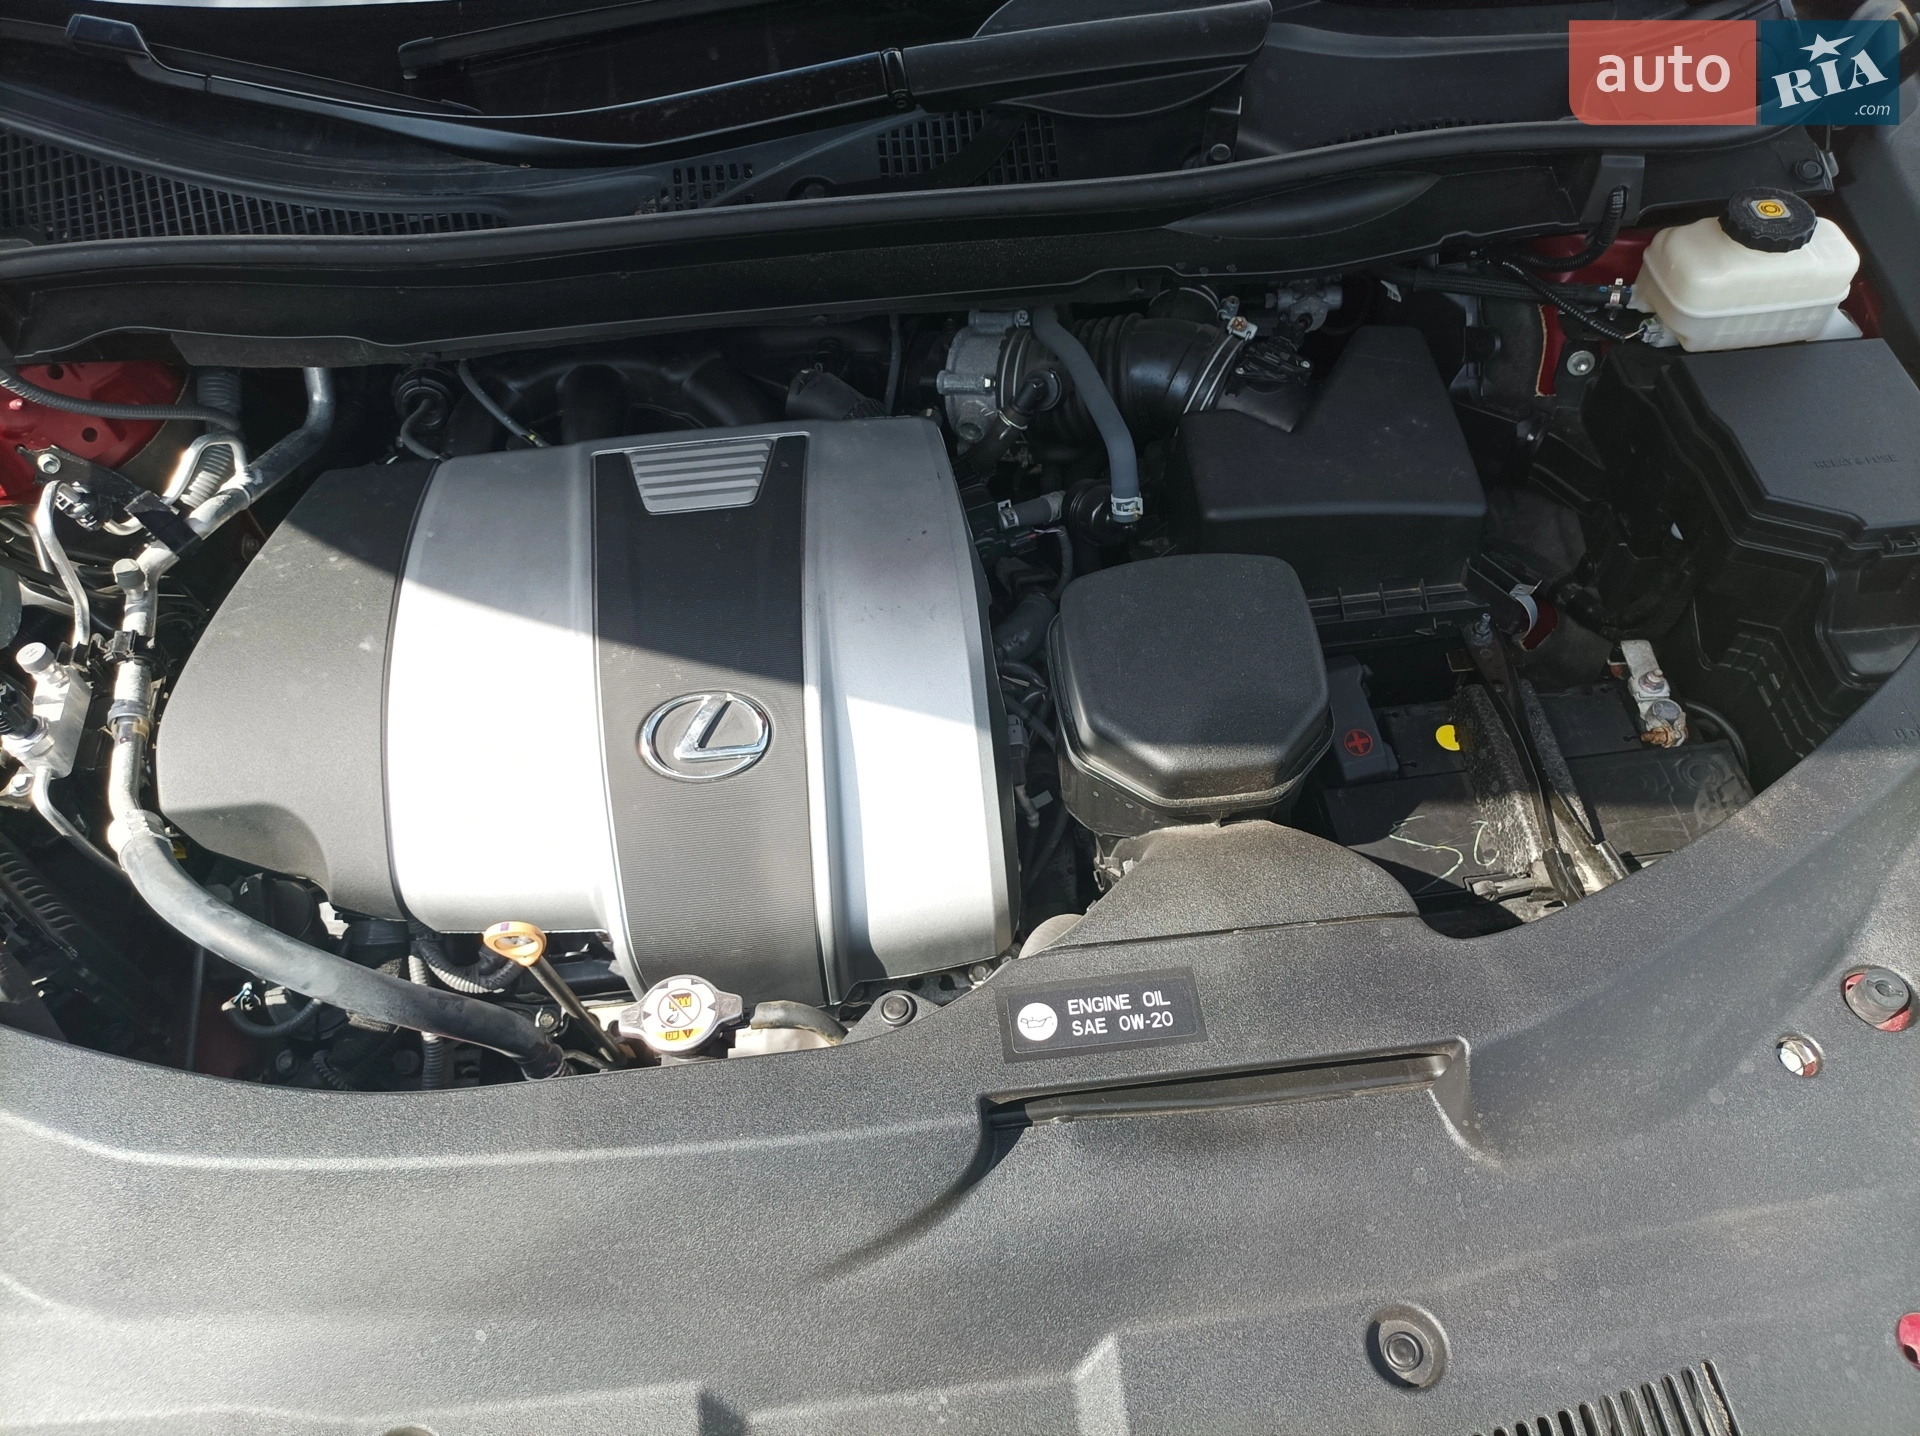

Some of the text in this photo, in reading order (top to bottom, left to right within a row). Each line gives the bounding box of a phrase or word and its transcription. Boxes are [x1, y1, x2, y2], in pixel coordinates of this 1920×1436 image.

[1067, 990, 1171, 1016] ENGINE OIL
[1072, 1011, 1174, 1037] SAE 0W-20
